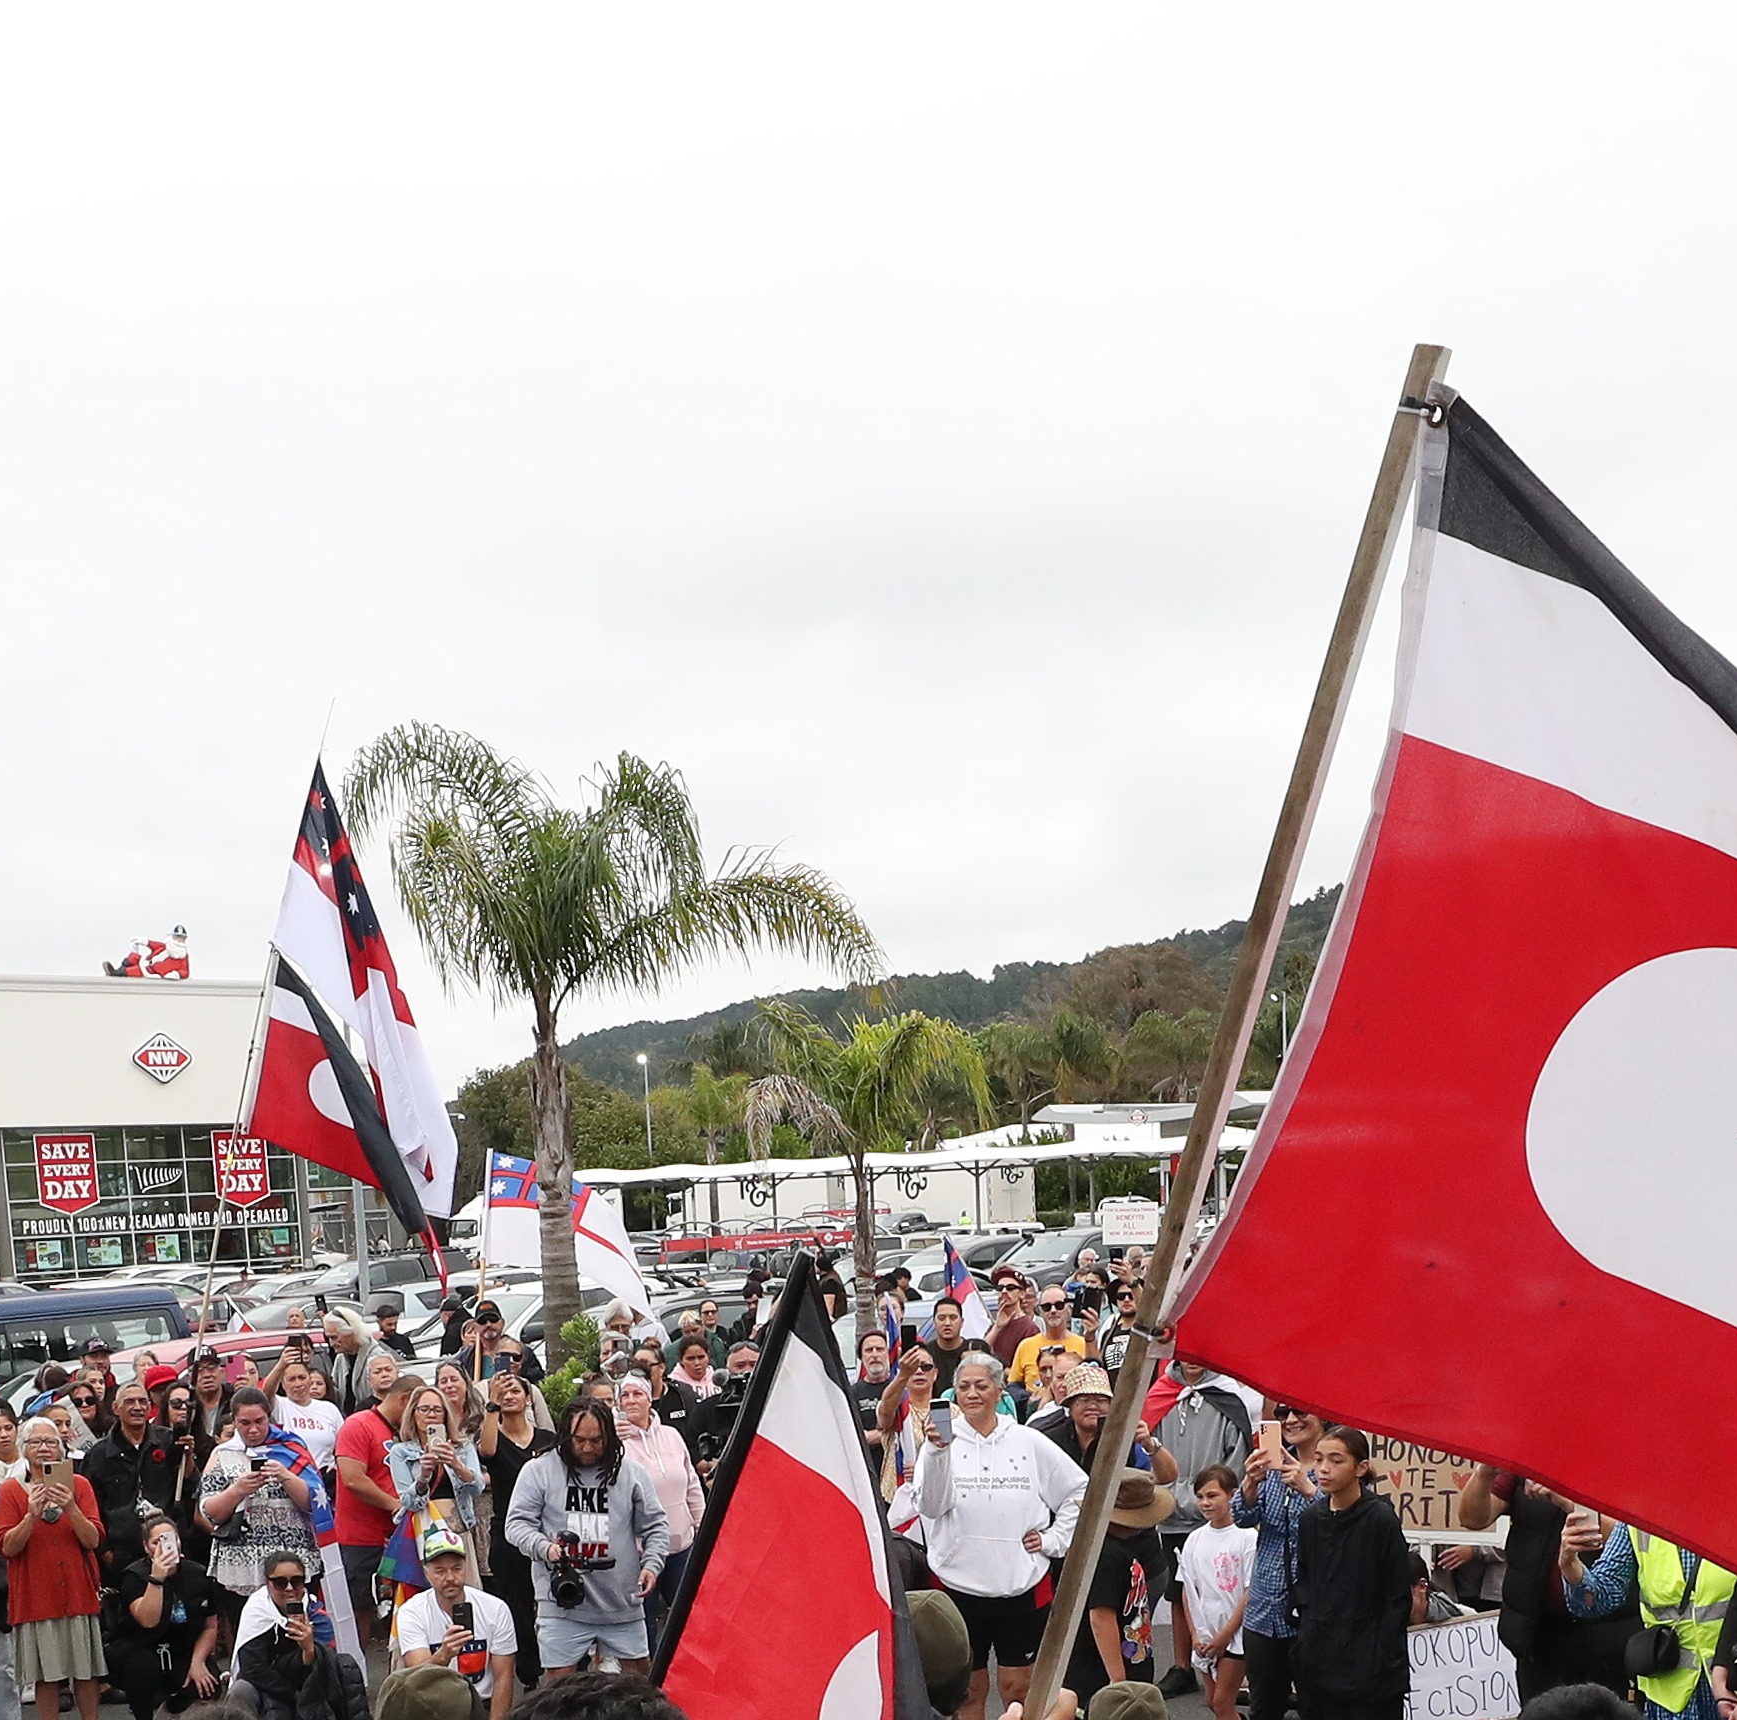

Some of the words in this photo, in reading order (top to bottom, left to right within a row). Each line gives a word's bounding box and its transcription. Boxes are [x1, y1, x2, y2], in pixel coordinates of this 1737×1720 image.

[147, 1050, 179, 1066] NW
[40, 1142, 90, 1160] SAVE
[43, 1163, 91, 1178] EVERY
[44, 1179, 93, 1201] DAY
[23, 1219, 74, 1235] PROUDLY
[104, 1215, 127, 1231] NEW
[128, 1213, 176, 1230] ZEALAND
[177, 1210, 211, 1228] OWNED
[236, 1206, 289, 1225] OPERATED
[1406, 1467, 1437, 1489] TE
[565, 1485, 610, 1514] AKE
